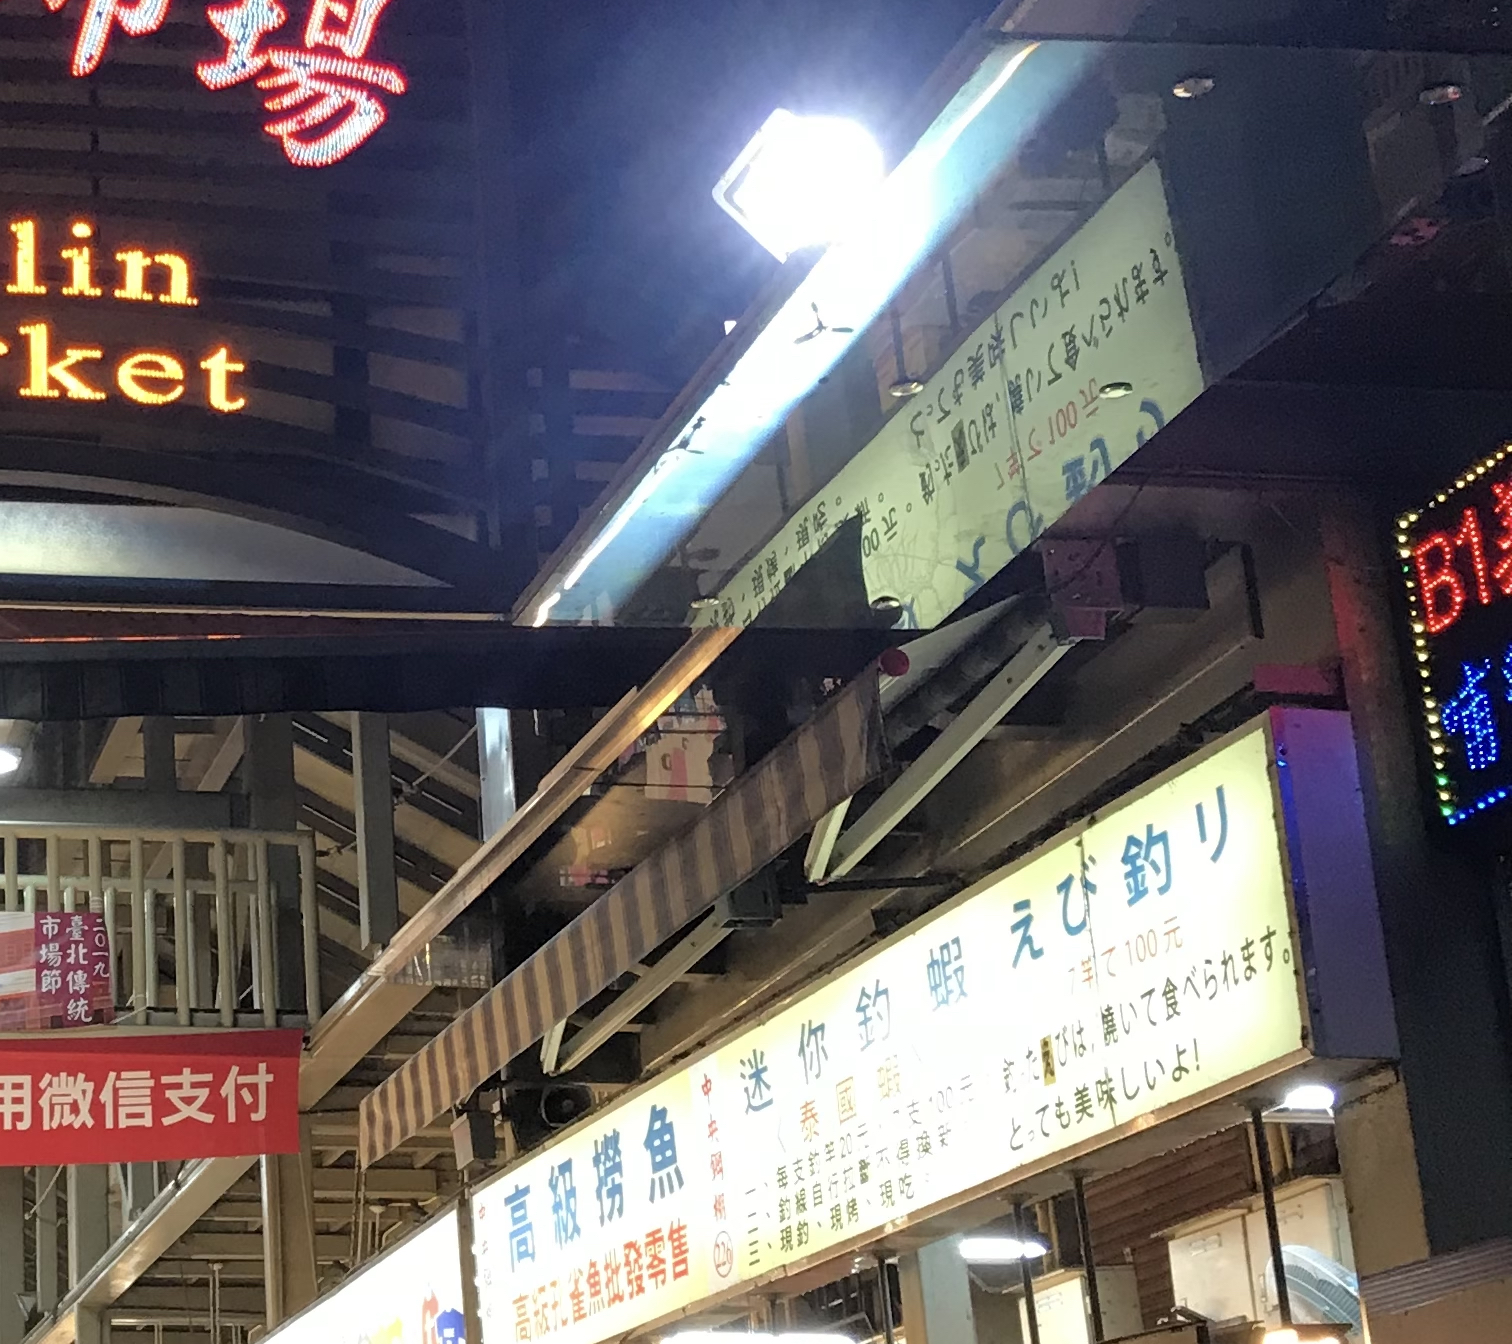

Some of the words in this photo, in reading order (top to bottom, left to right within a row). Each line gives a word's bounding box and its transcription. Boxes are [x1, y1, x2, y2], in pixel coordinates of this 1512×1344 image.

[38, 914, 63, 994] 市場節
[64, 914, 93, 1023] 臺北傳統
[739, 935, 969, 1116] 迷你釣蝦
[503, 1103, 685, 1273] 高級撈魚
